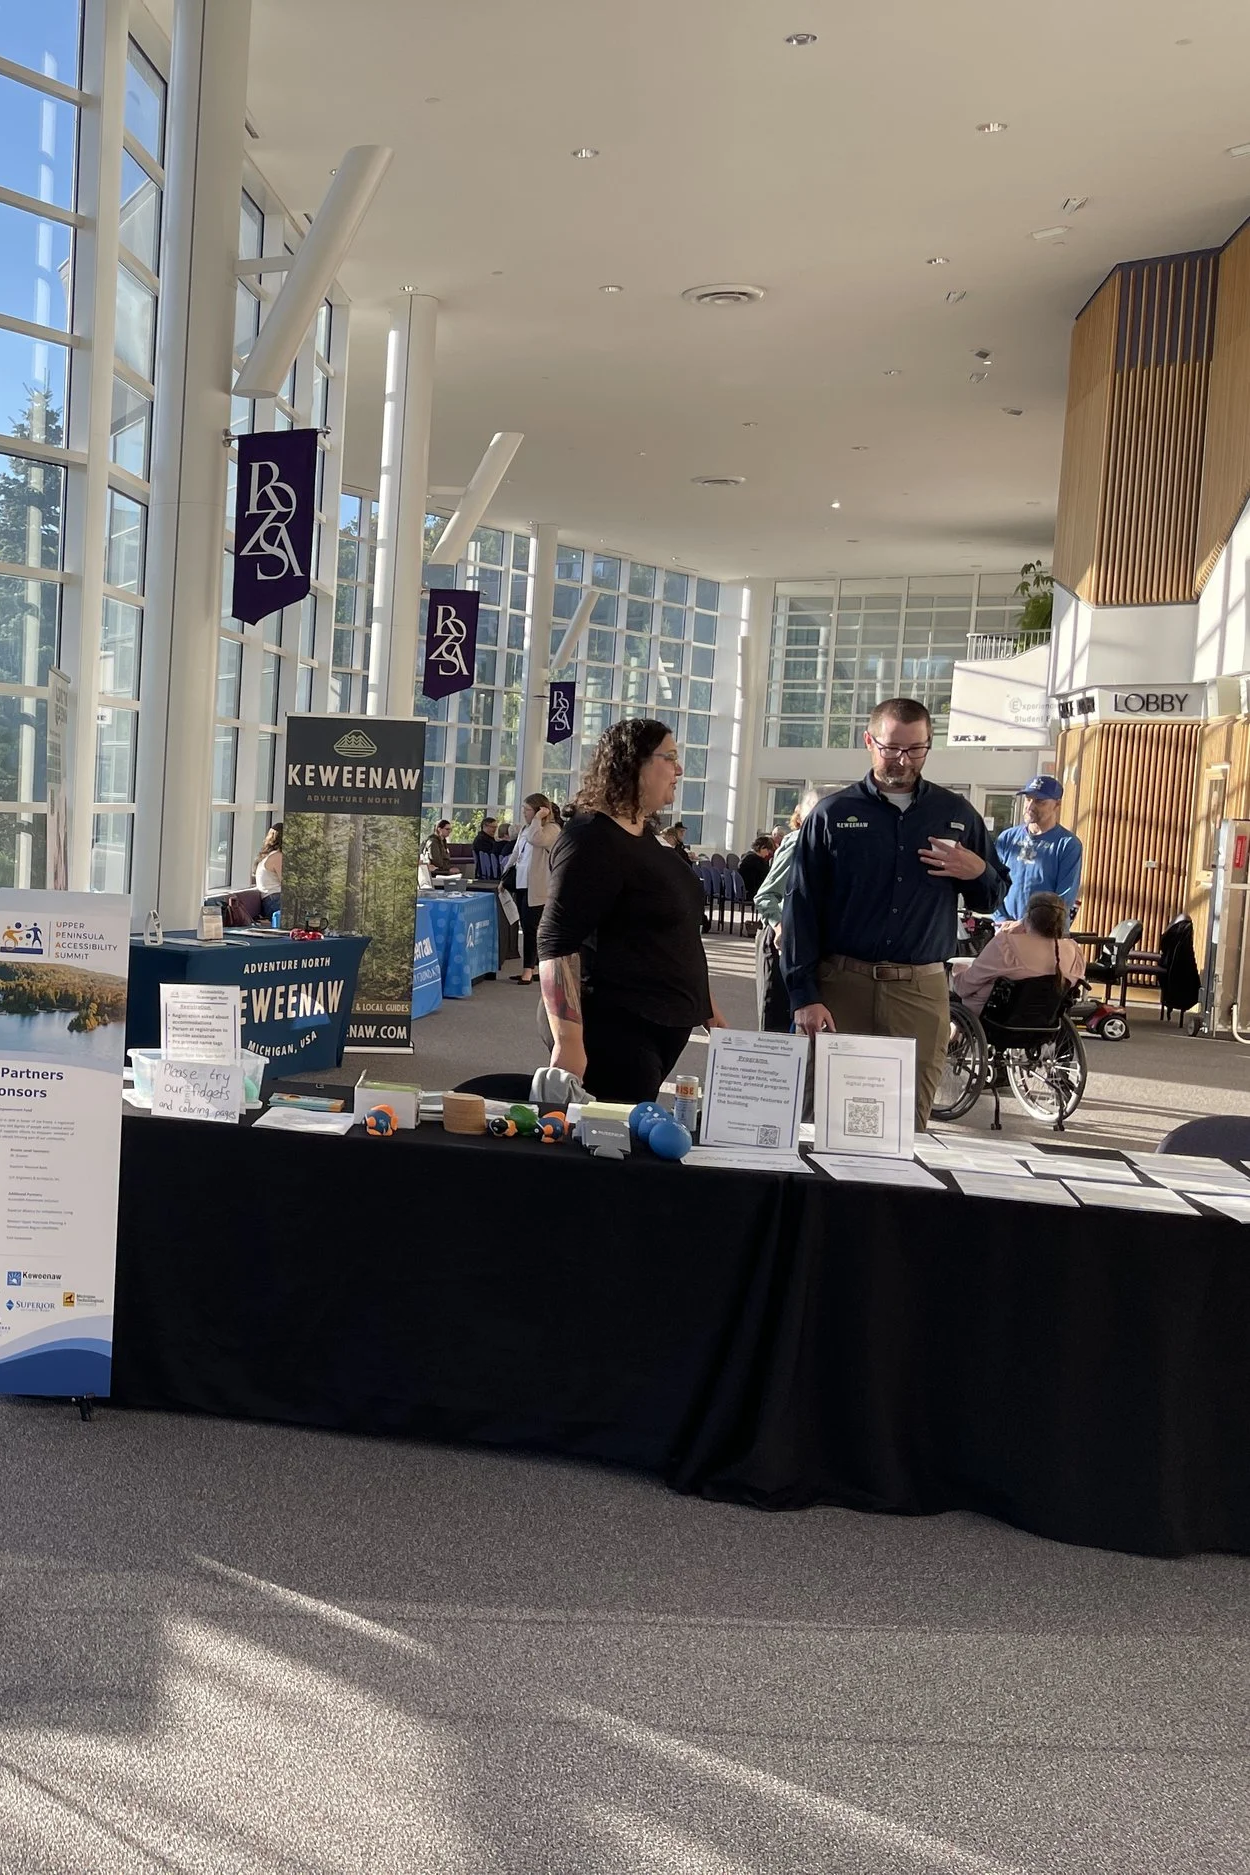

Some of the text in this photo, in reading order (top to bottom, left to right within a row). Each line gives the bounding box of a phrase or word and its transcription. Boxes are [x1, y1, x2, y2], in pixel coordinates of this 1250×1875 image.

[1009, 697, 1059, 715] Experienc
[1115, 693, 1189, 713] LOBBY
[287, 764, 420, 790] KEWEENAW
[307, 794, 400, 804] ADVENTURE NORTH
[55, 931, 104, 941] PENINSULA
[55, 942, 117, 951] ACCESSIBILITY
[54, 952, 89, 960] SUMMIT
[243, 957, 331, 974] ADVENTURE NORTH
[240, 979, 344, 1026] EWEENAW
[363, 1003, 383, 1011] LOCAL
[385, 1003, 409, 1012] GUIDES
[347, 1025, 407, 1039] NAW.COM
[247, 1040, 297, 1057] MICHIGAN,
[300, 1031, 317, 1048] USA
[1, 1066, 64, 1081] Partners
[164, 1063, 230, 1089] Please try
[165, 1082, 230, 1103] our fidgets
[159, 1099, 237, 1120] and coloring pages
[22, 1271, 62, 1280] Keweenaw
[15, 1301, 55, 1310] SUPERIOR
